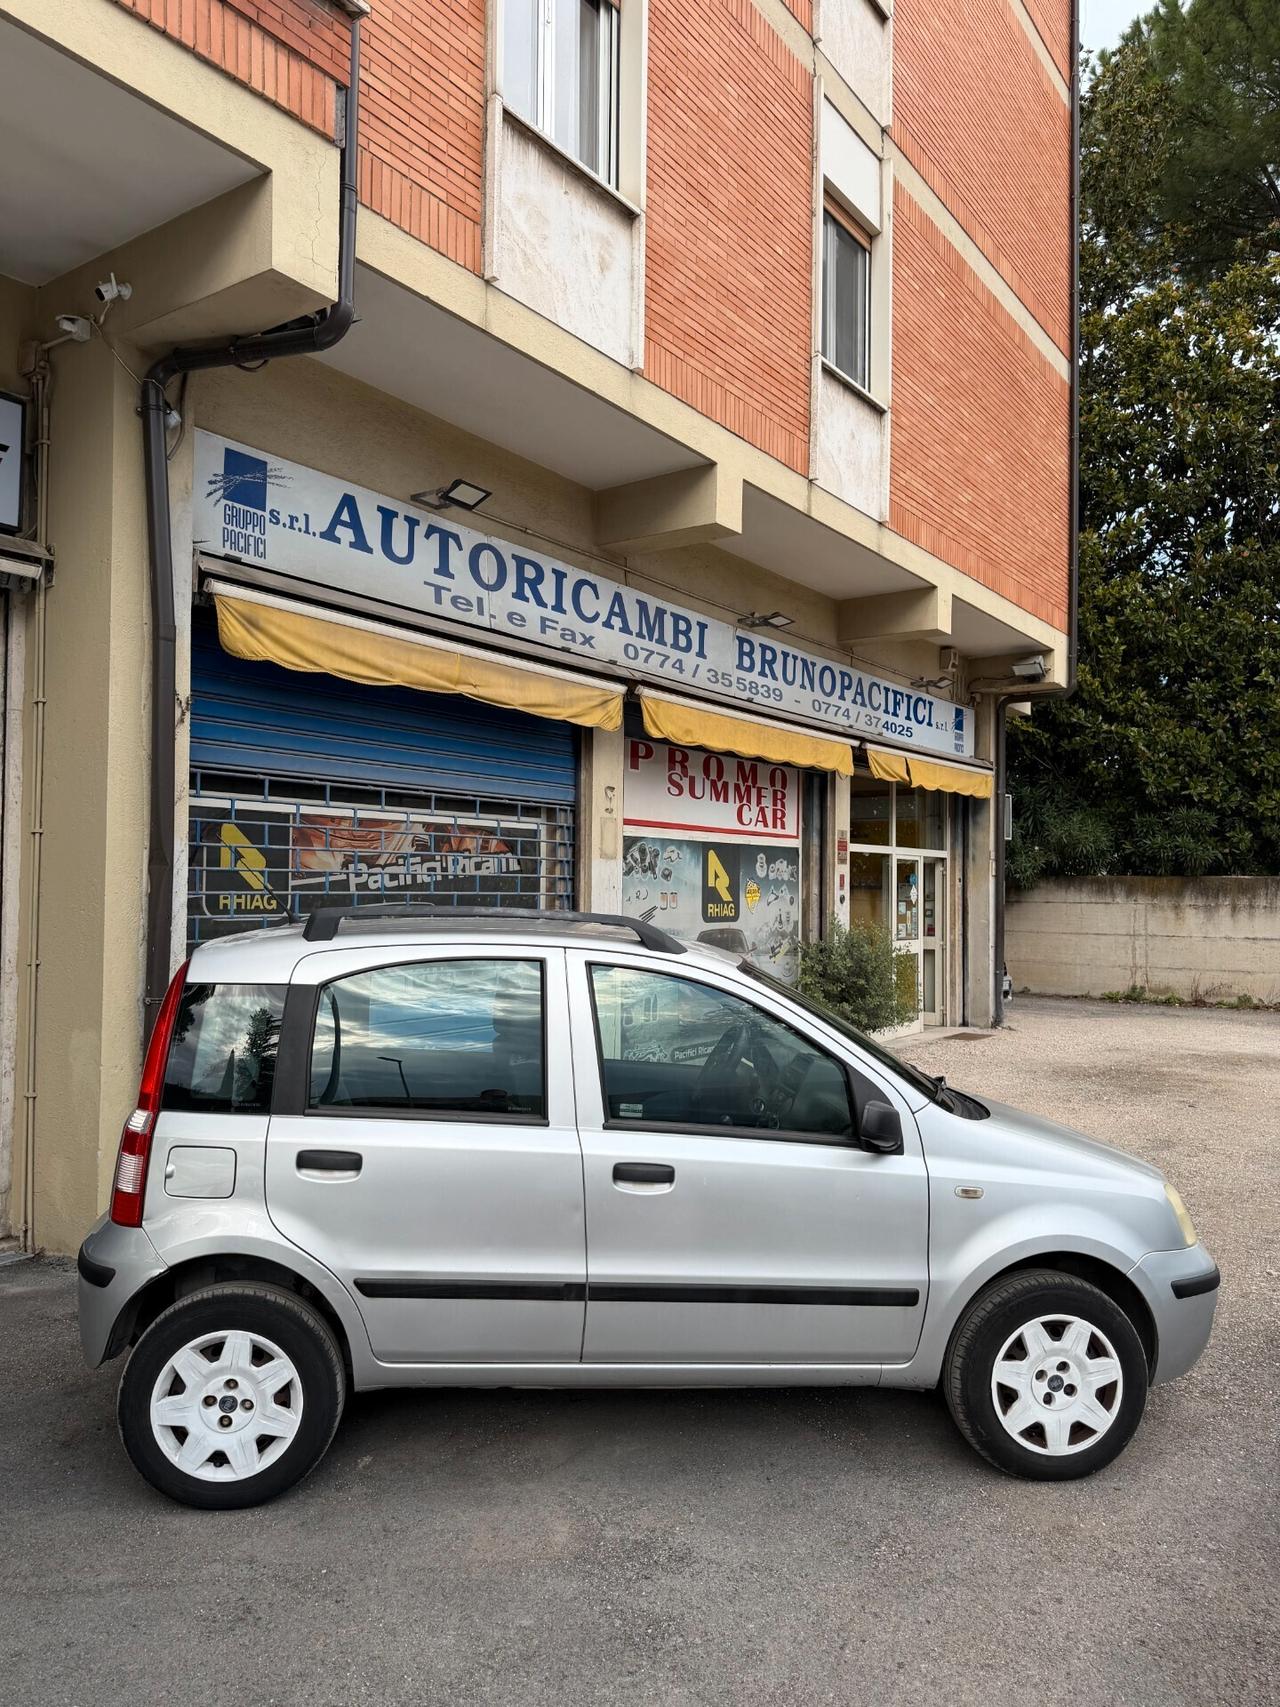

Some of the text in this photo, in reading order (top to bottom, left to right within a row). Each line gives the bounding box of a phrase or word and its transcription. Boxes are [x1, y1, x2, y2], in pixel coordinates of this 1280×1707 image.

[223, 503, 266, 536] GRUPPO
[222, 526, 267, 560] PACIFICI
[268, 508, 317, 538] s.r.l.
[319, 492, 708, 660] AUTORICAMBI
[506, 610, 527, 628] e
[539, 615, 596, 649] Fax
[629, 739, 789, 792] PROMO
[667, 771, 788, 810] SUMMER
[736, 803, 788, 830] CAR
[219, 894, 277, 910] RHIAG
[707, 903, 735, 918] RHIAG
